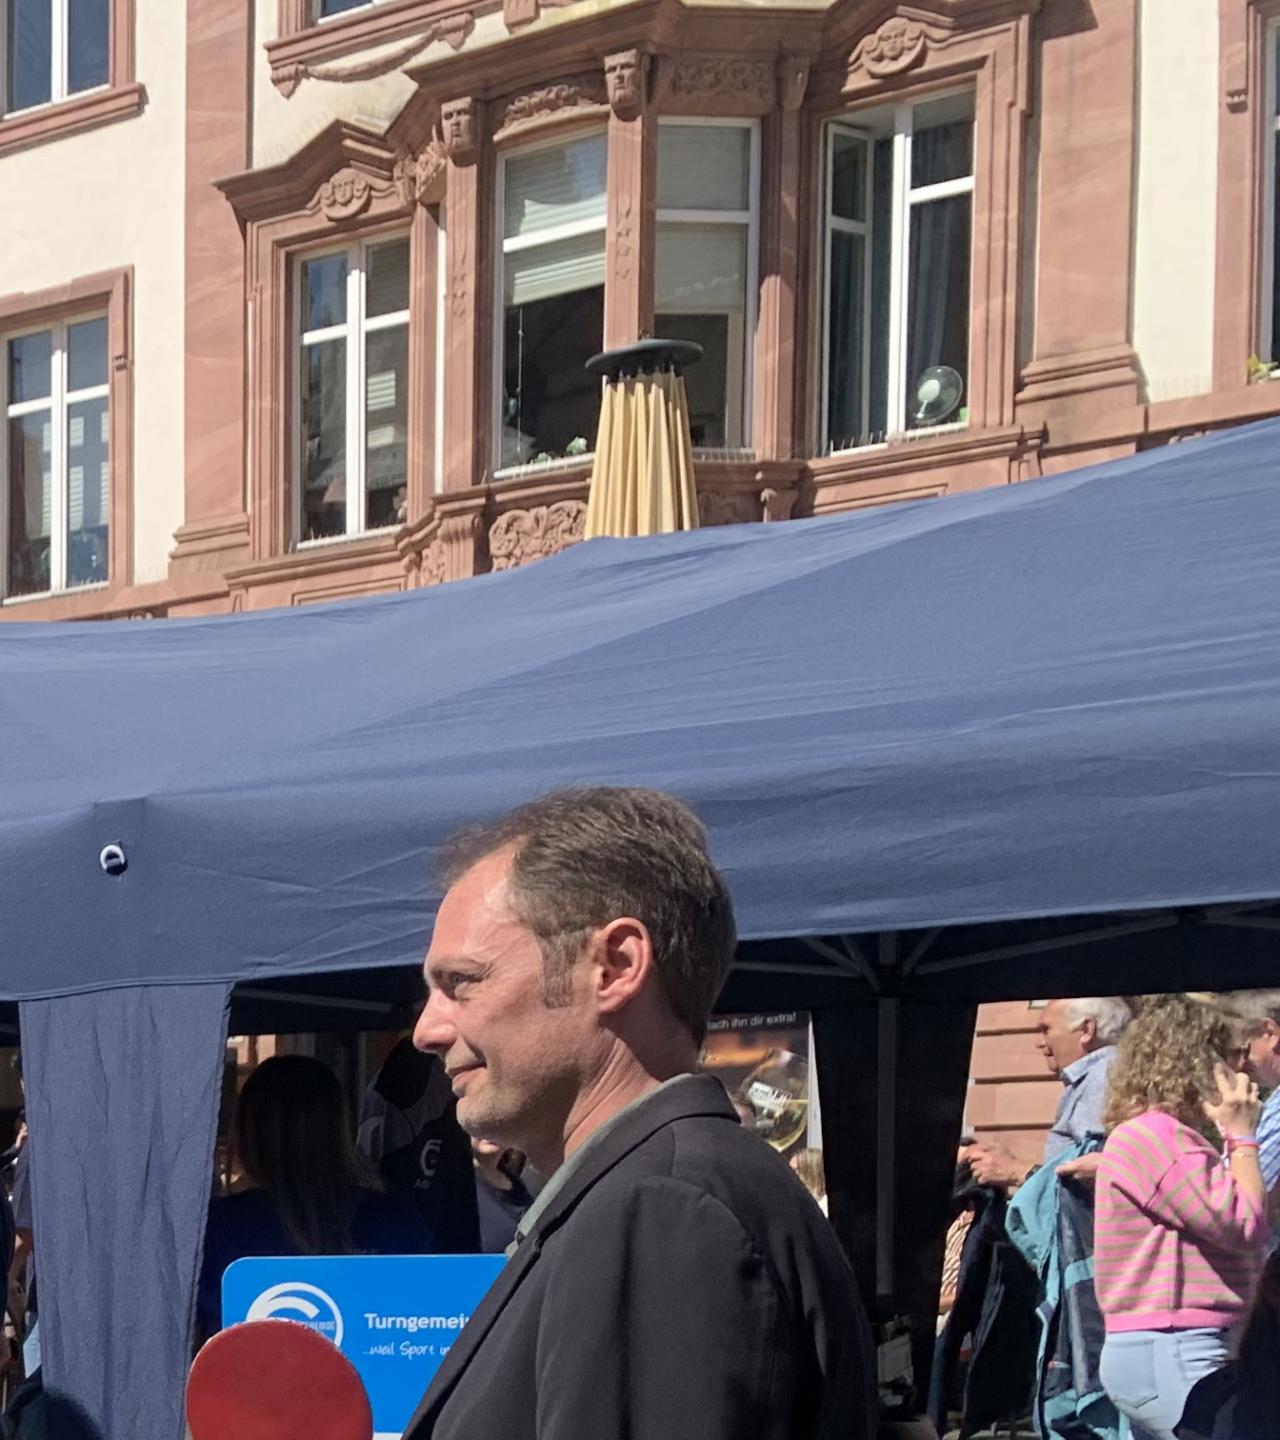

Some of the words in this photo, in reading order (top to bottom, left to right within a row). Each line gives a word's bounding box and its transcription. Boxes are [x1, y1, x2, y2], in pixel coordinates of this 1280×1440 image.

[708, 1019, 729, 1030] ach
[732, 1017, 748, 1028] ihn
[750, 1015, 765, 1026] dir
[766, 1012, 797, 1024] extra!
[364, 1313, 469, 1332] Turngemei
[399, 1341, 434, 1360] Sport
